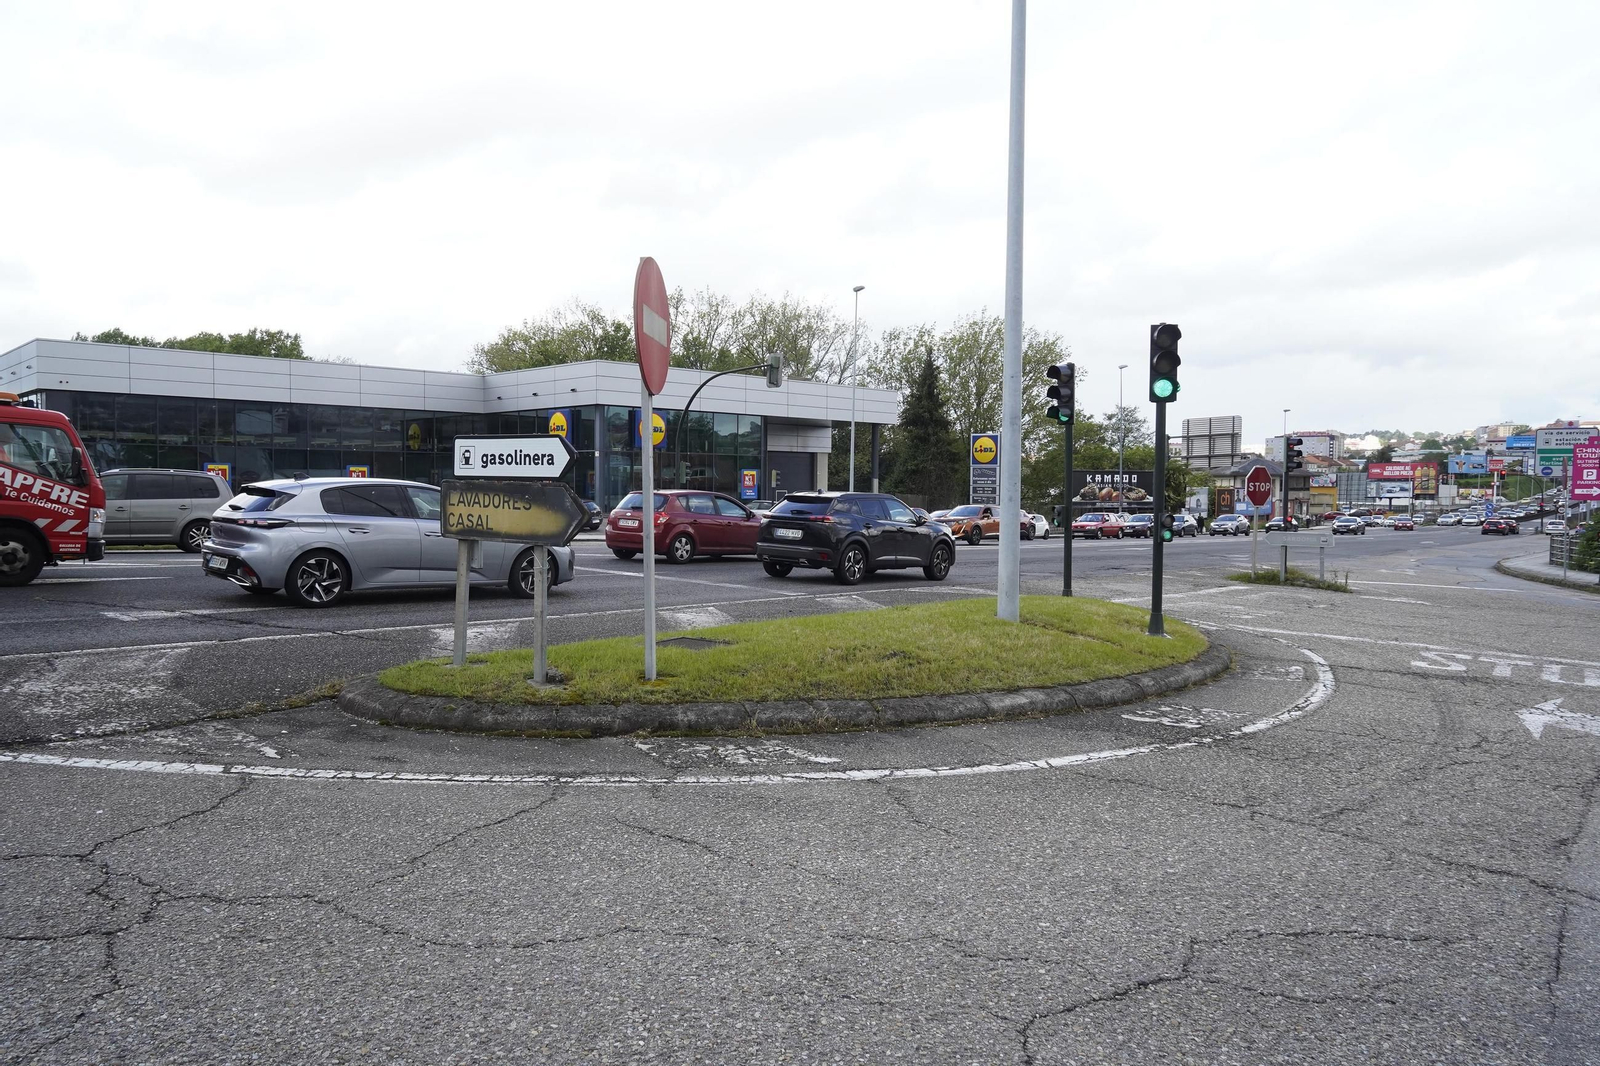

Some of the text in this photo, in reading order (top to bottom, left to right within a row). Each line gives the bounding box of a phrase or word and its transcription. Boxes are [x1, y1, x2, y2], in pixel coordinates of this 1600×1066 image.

[481, 449, 555, 468] gasolinera
[1086, 474, 1137, 483] KAMADO
[1248, 482, 1270, 492] STOP
[5, 486, 75, 516] Te Cuidamos
[448, 492, 532, 511] LAVADORES
[447, 513, 494, 531] CASAL
